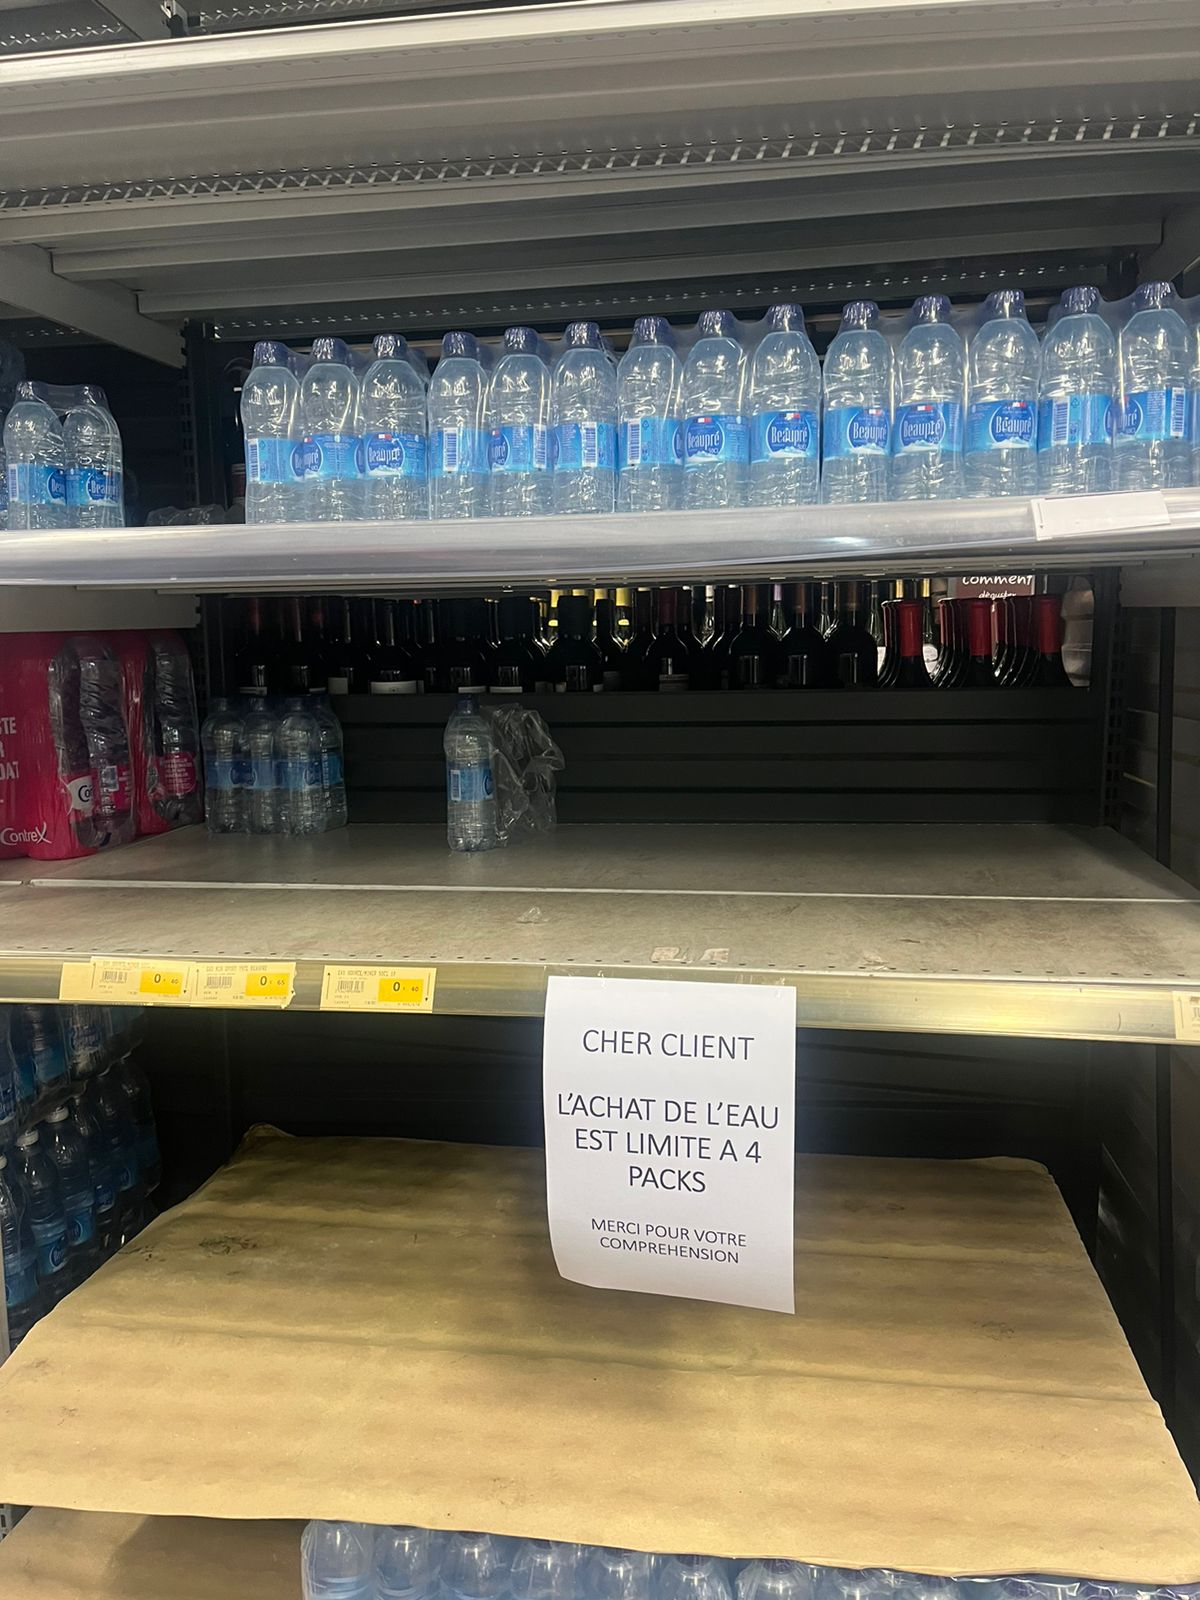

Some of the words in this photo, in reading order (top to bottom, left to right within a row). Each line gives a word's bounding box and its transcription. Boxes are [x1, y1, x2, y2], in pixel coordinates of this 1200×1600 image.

[688, 430, 720, 451] Beaupré
[771, 426, 808, 446] Beaupré
[903, 419, 941, 439] Beaupré
[582, 1029, 652, 1056] CHER
[661, 1033, 755, 1061] CLIENT
[557, 1092, 657, 1121] L'ACHAT
[664, 1099, 698, 1124] DE
[707, 1101, 779, 1130] L'EAU
[575, 1127, 619, 1152] EST
[626, 1131, 712, 1160] LIMITE
[718, 1138, 738, 1163] A
[745, 1140, 762, 1165] 4
[628, 1165, 706, 1193] PACKS
[591, 1218, 640, 1235] MERCI
[645, 1223, 690, 1241] POUR
[694, 1229, 747, 1248] VOTRE
[599, 1236, 739, 1264] COMPREHENSION
